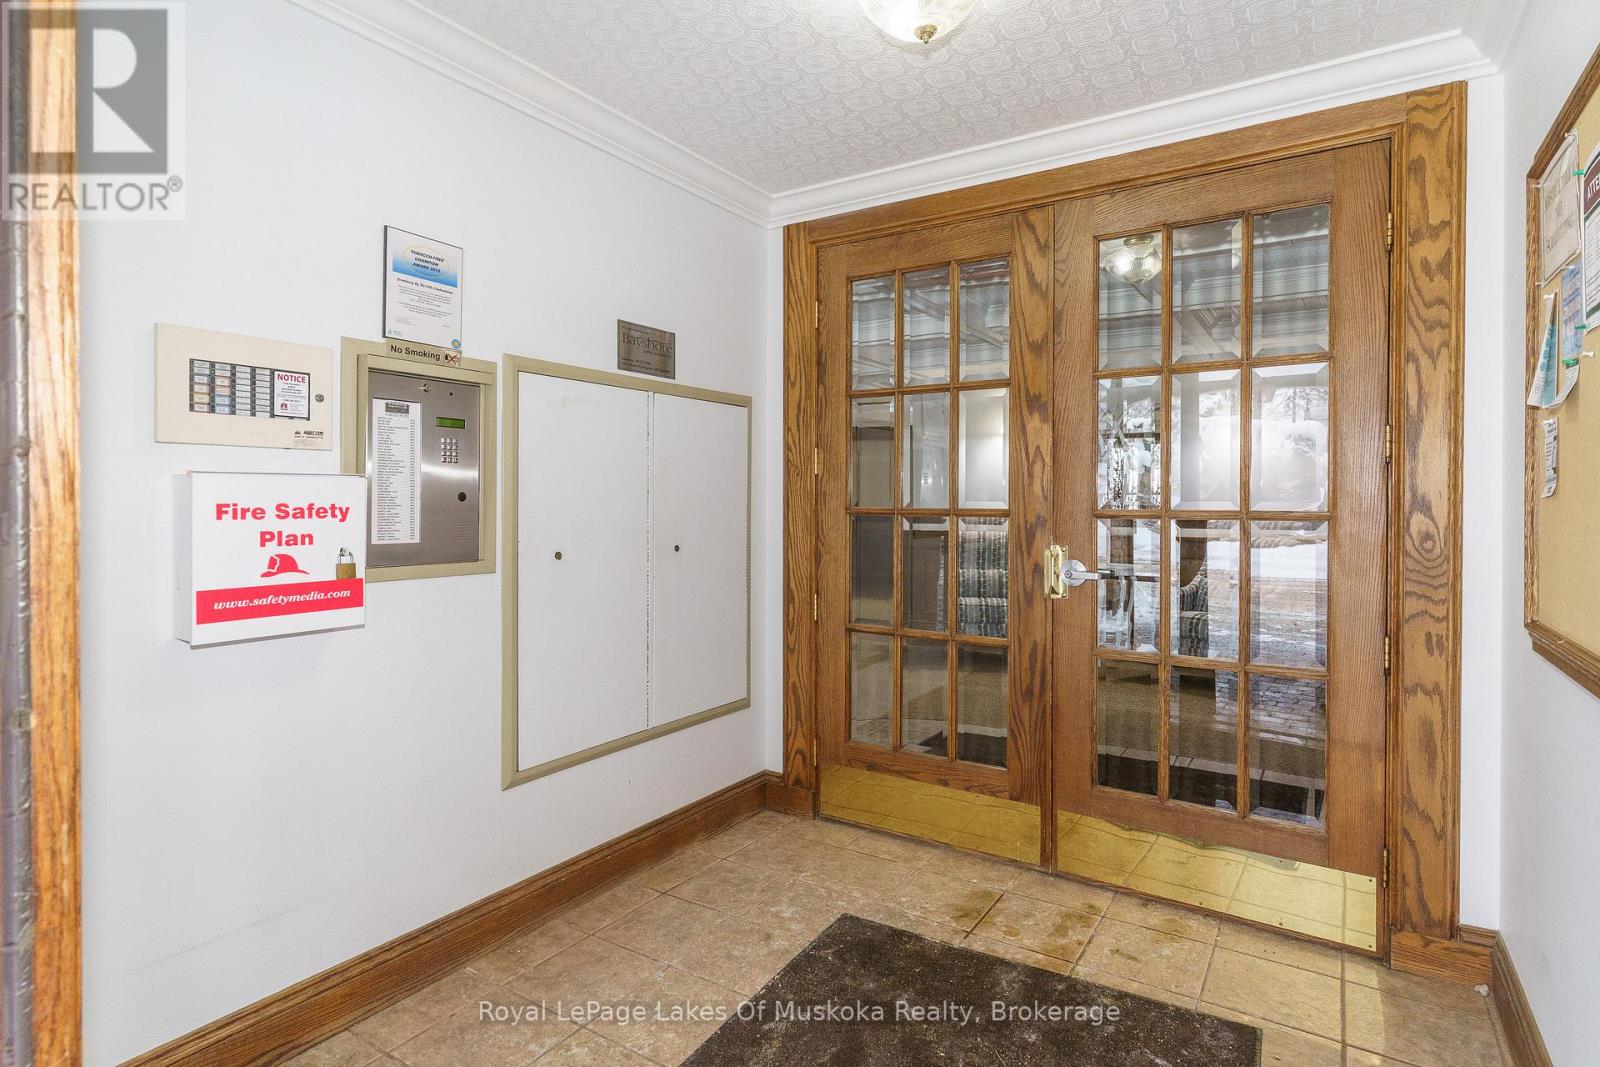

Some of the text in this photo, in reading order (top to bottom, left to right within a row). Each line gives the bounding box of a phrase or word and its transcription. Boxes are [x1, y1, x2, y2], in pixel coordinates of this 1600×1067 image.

[1587, 172, 1600, 201] ATTE
[412, 262, 429, 270] AWARD
[414, 257, 439, 267] CHAMPION
[390, 344, 441, 362] No Smoking
[277, 373, 306, 384] NOTICE
[215, 502, 351, 523] Fire Safety
[259, 530, 314, 547] Plan
[213, 589, 351, 611] www.safetymedia.com
